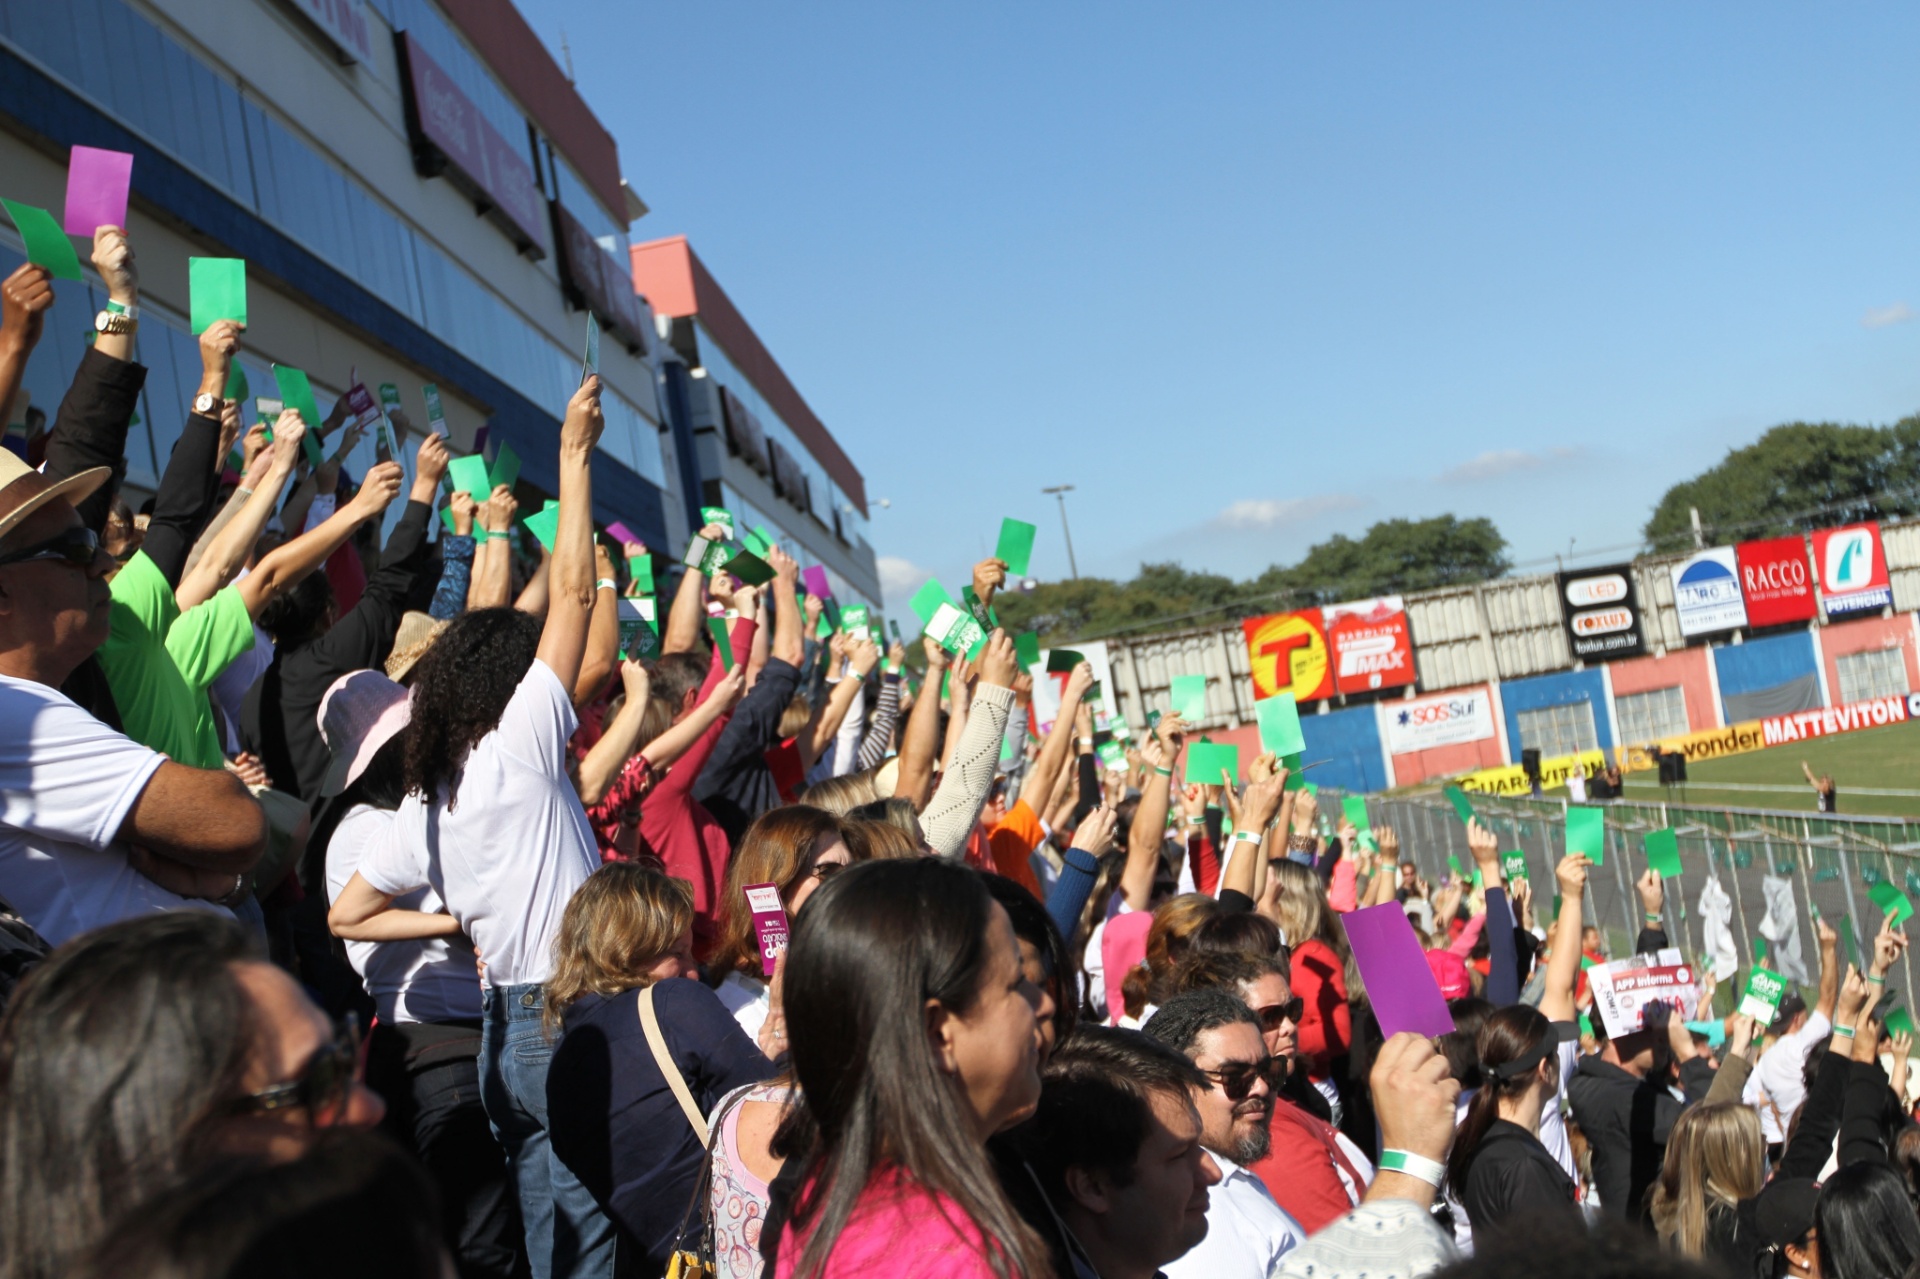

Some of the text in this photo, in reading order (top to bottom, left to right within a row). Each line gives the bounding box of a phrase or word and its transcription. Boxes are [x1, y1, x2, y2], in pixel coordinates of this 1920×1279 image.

[1744, 558, 1805, 592] RACCO
[1826, 588, 1890, 613] POTENCIAL
[1577, 612, 1627, 632] FOXLUX
[1260, 632, 1312, 690] T
[1413, 699, 1475, 726] SOSSul
[1762, 697, 1905, 745] MATTEVITON
[1683, 727, 1761, 757] vonder
[1460, 759, 1606, 796] GUARVITN
[1615, 978, 1635, 992] APP
